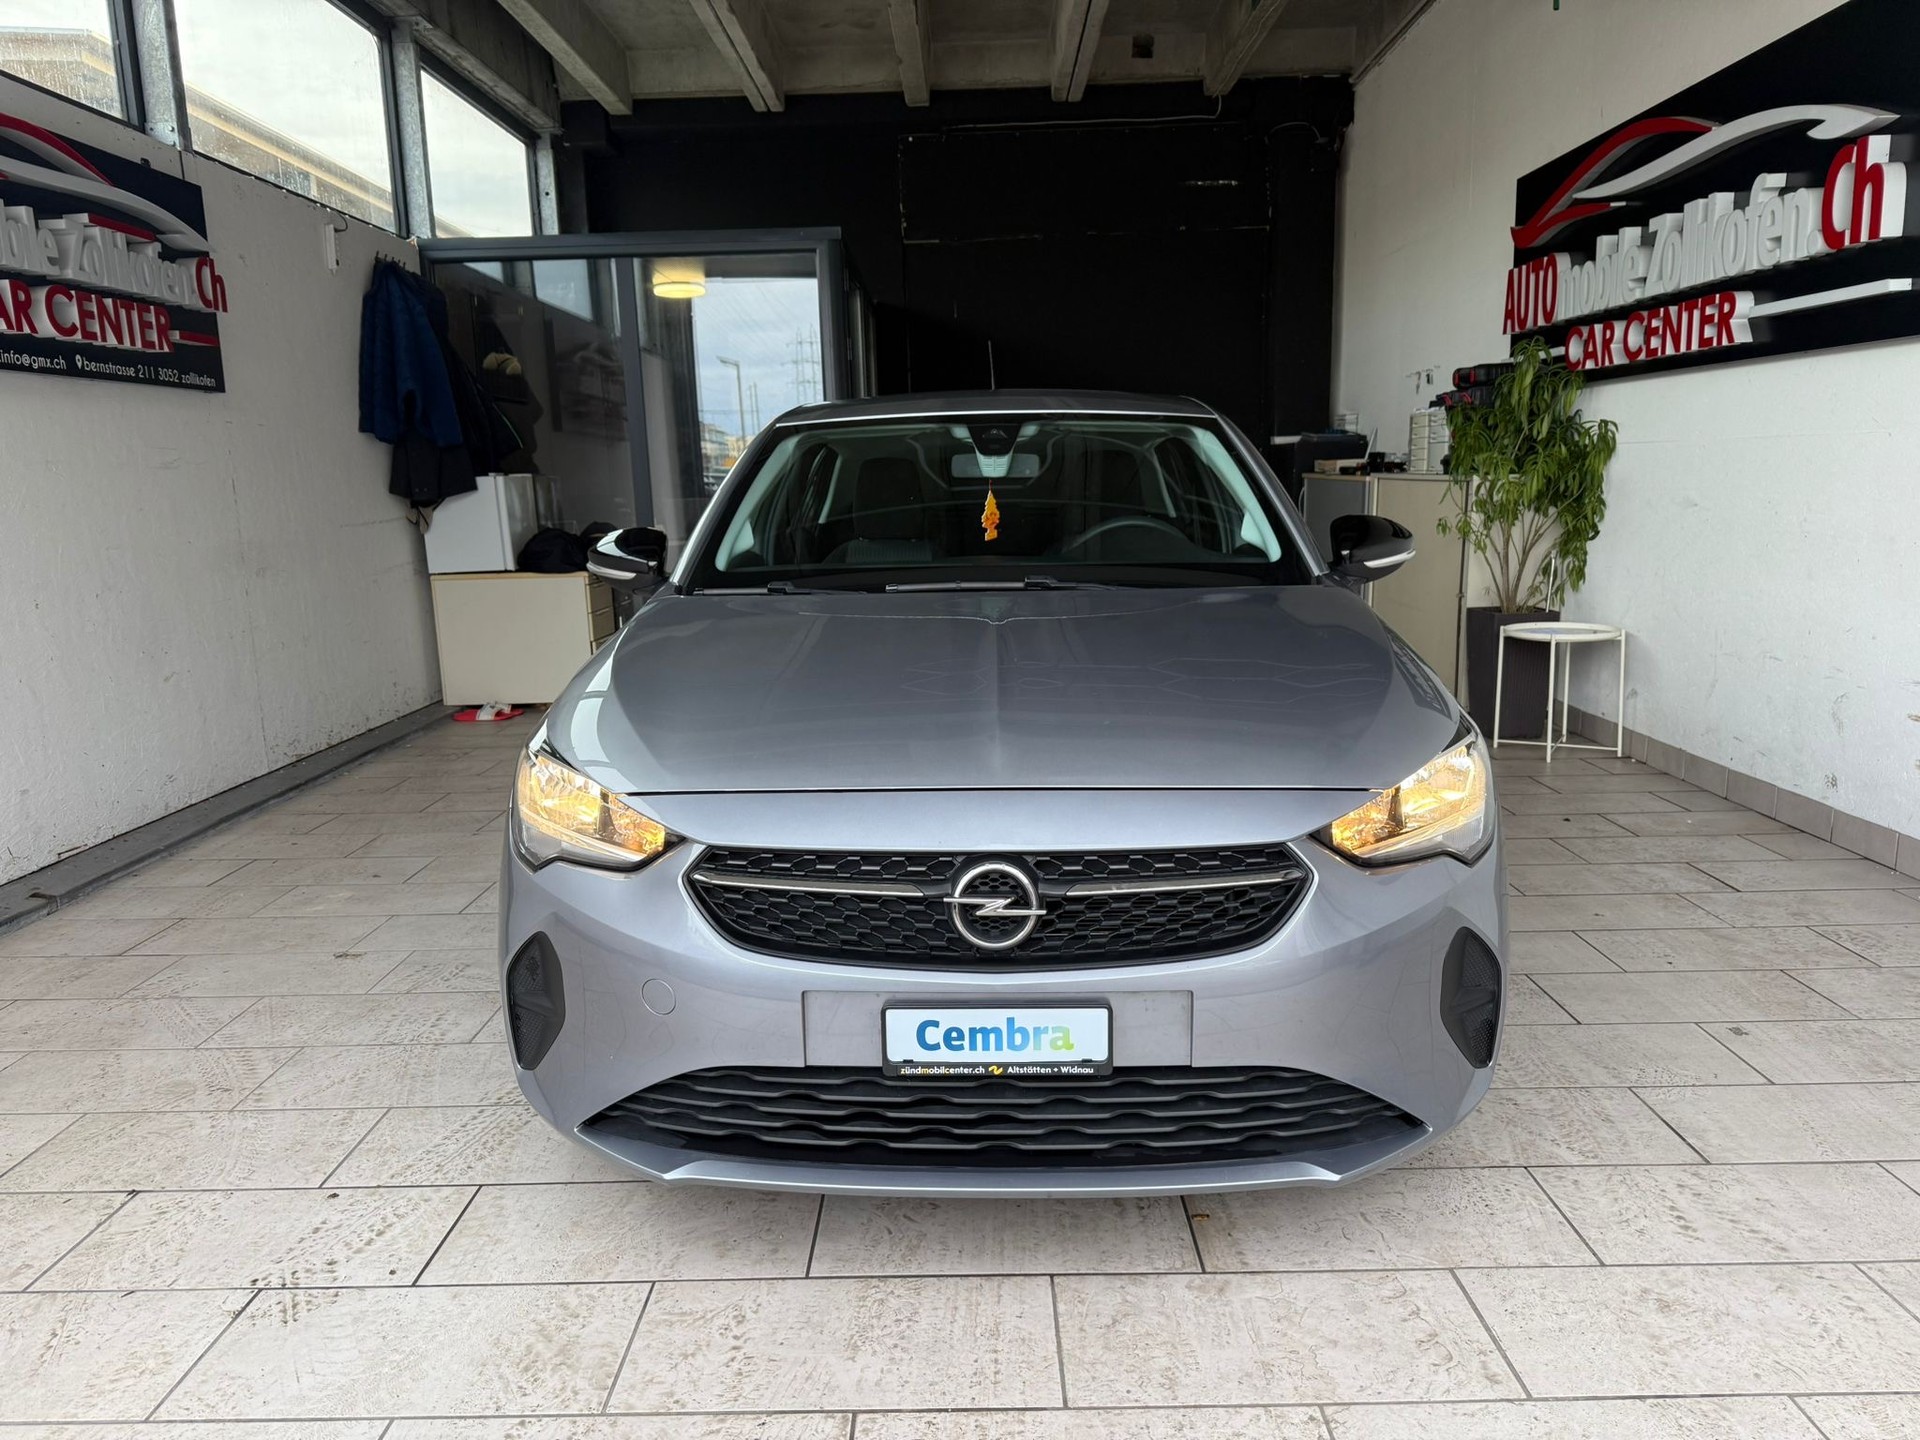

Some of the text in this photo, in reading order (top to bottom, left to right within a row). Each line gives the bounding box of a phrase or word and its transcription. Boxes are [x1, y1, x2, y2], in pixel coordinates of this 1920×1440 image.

[45, 284, 174, 352] CENTER
[1564, 290, 1739, 371] CAR CENTER
[83, 356, 135, 377] bernstrasse
[138, 364, 155, 379] 211
[158, 367, 180, 383] 3052
[916, 1017, 1074, 1052] Cembra
[900, 1065, 985, 1075] zündmobilcenter.ch
[1007, 1065, 1051, 1074] Altstätten
[1061, 1065, 1094, 1074] Widnau
